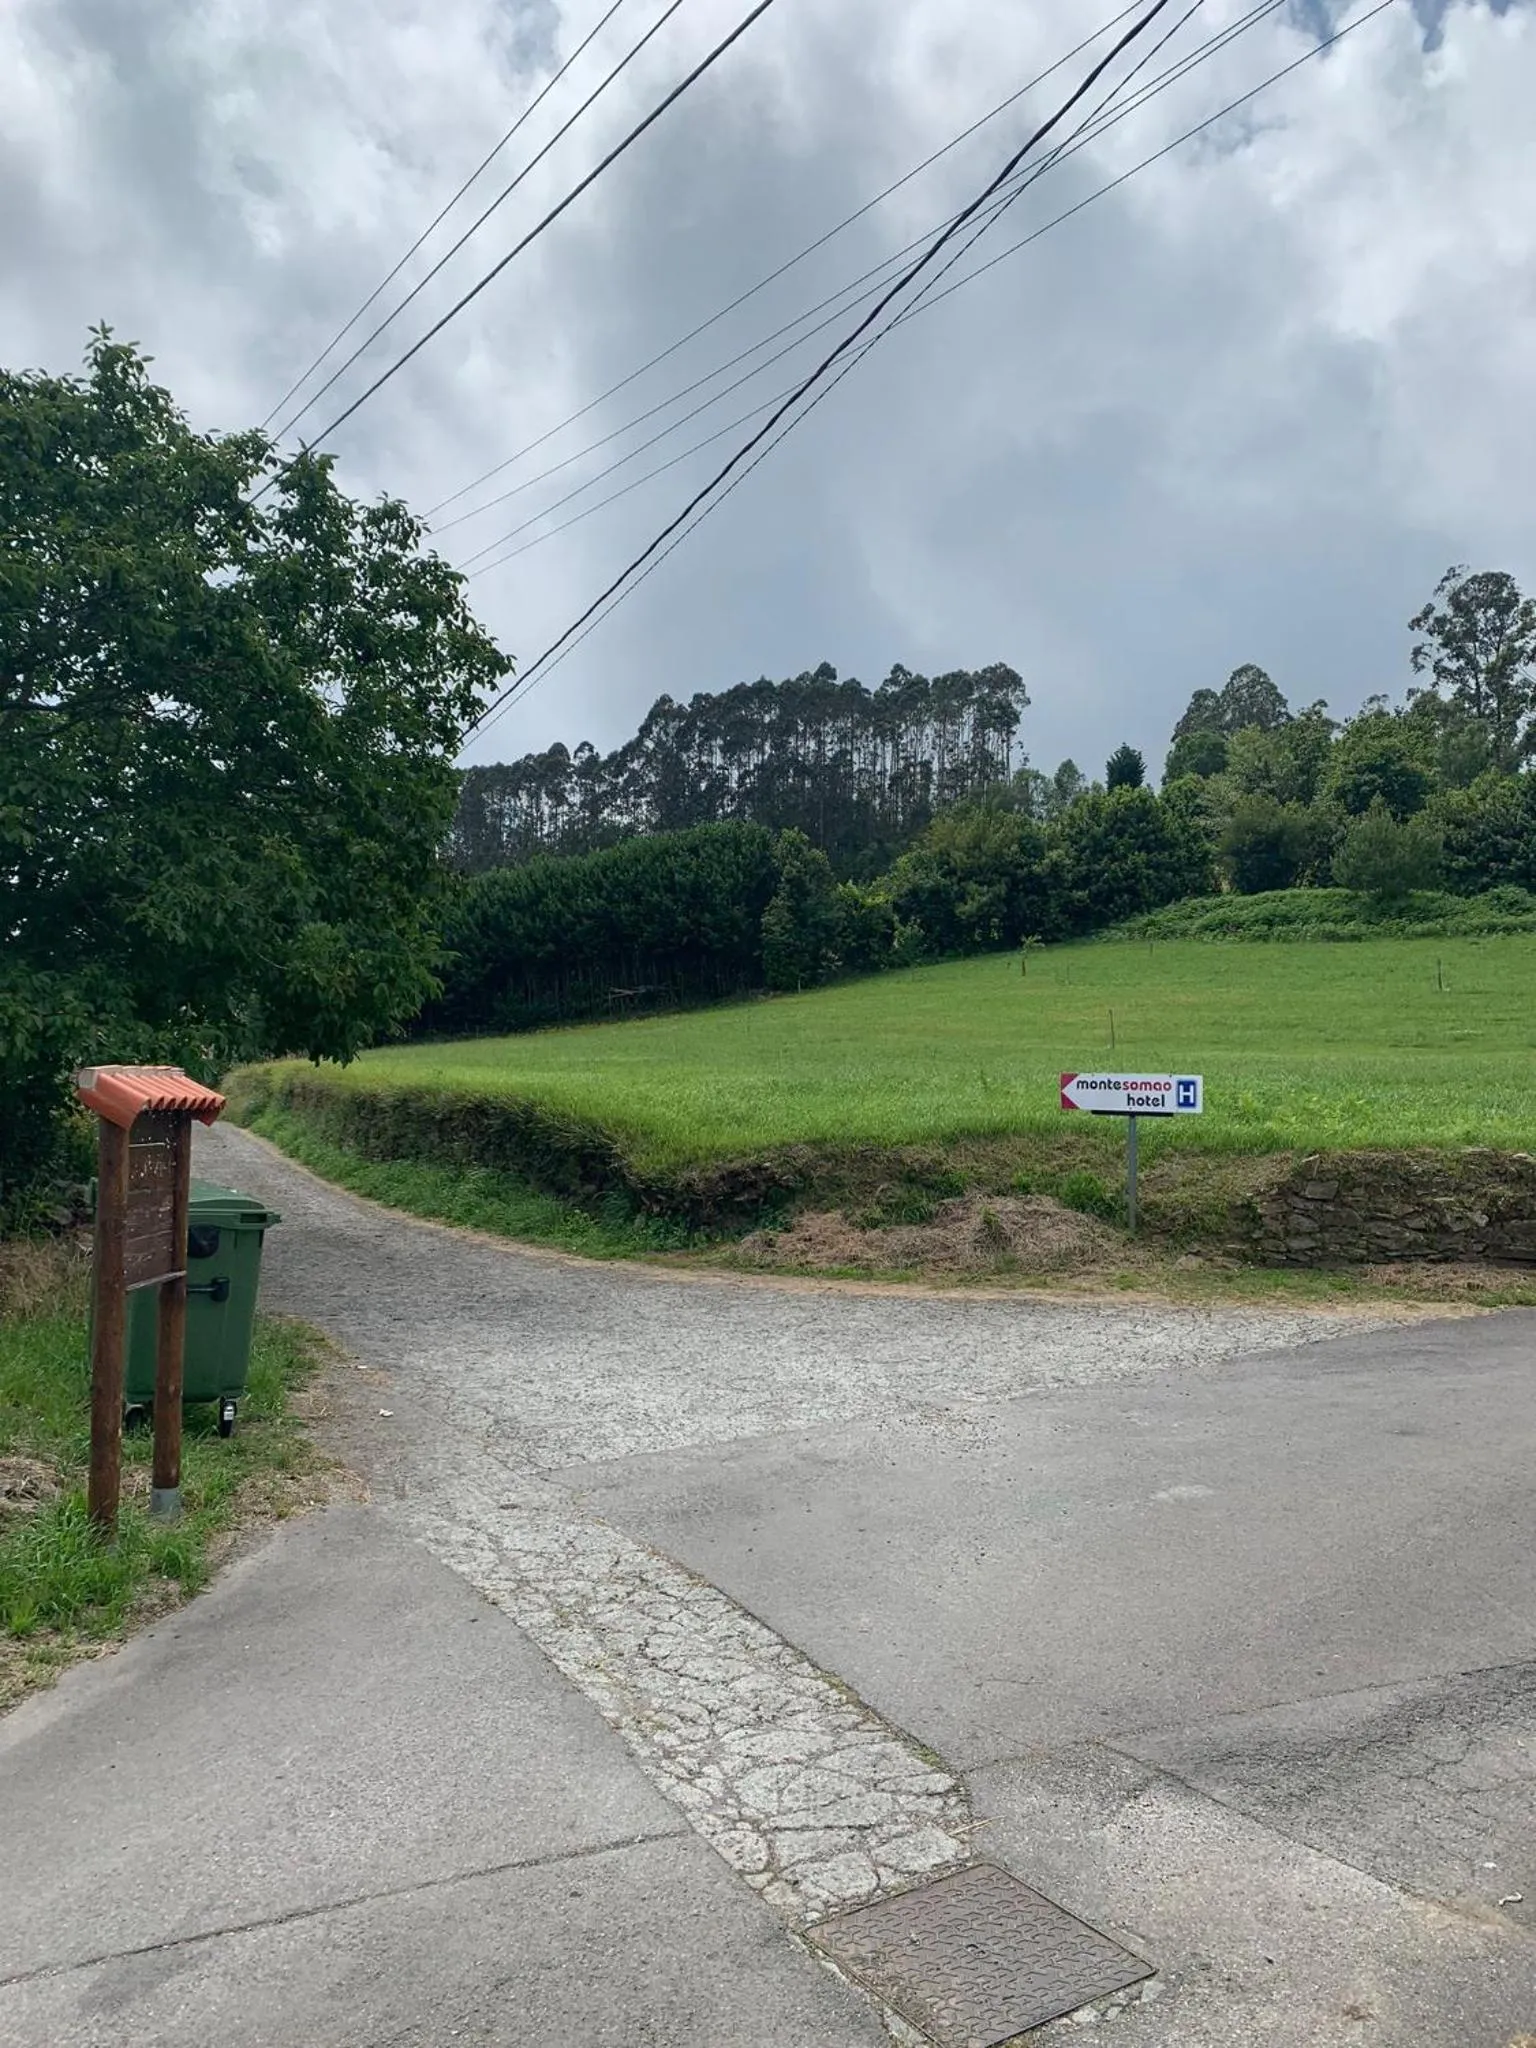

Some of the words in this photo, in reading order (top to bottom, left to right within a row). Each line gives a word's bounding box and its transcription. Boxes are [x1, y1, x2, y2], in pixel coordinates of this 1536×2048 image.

[1076, 1078, 1172, 1092] montesomao
[1127, 1093, 1165, 1107] hotel
[1179, 1083, 1194, 1104] H
